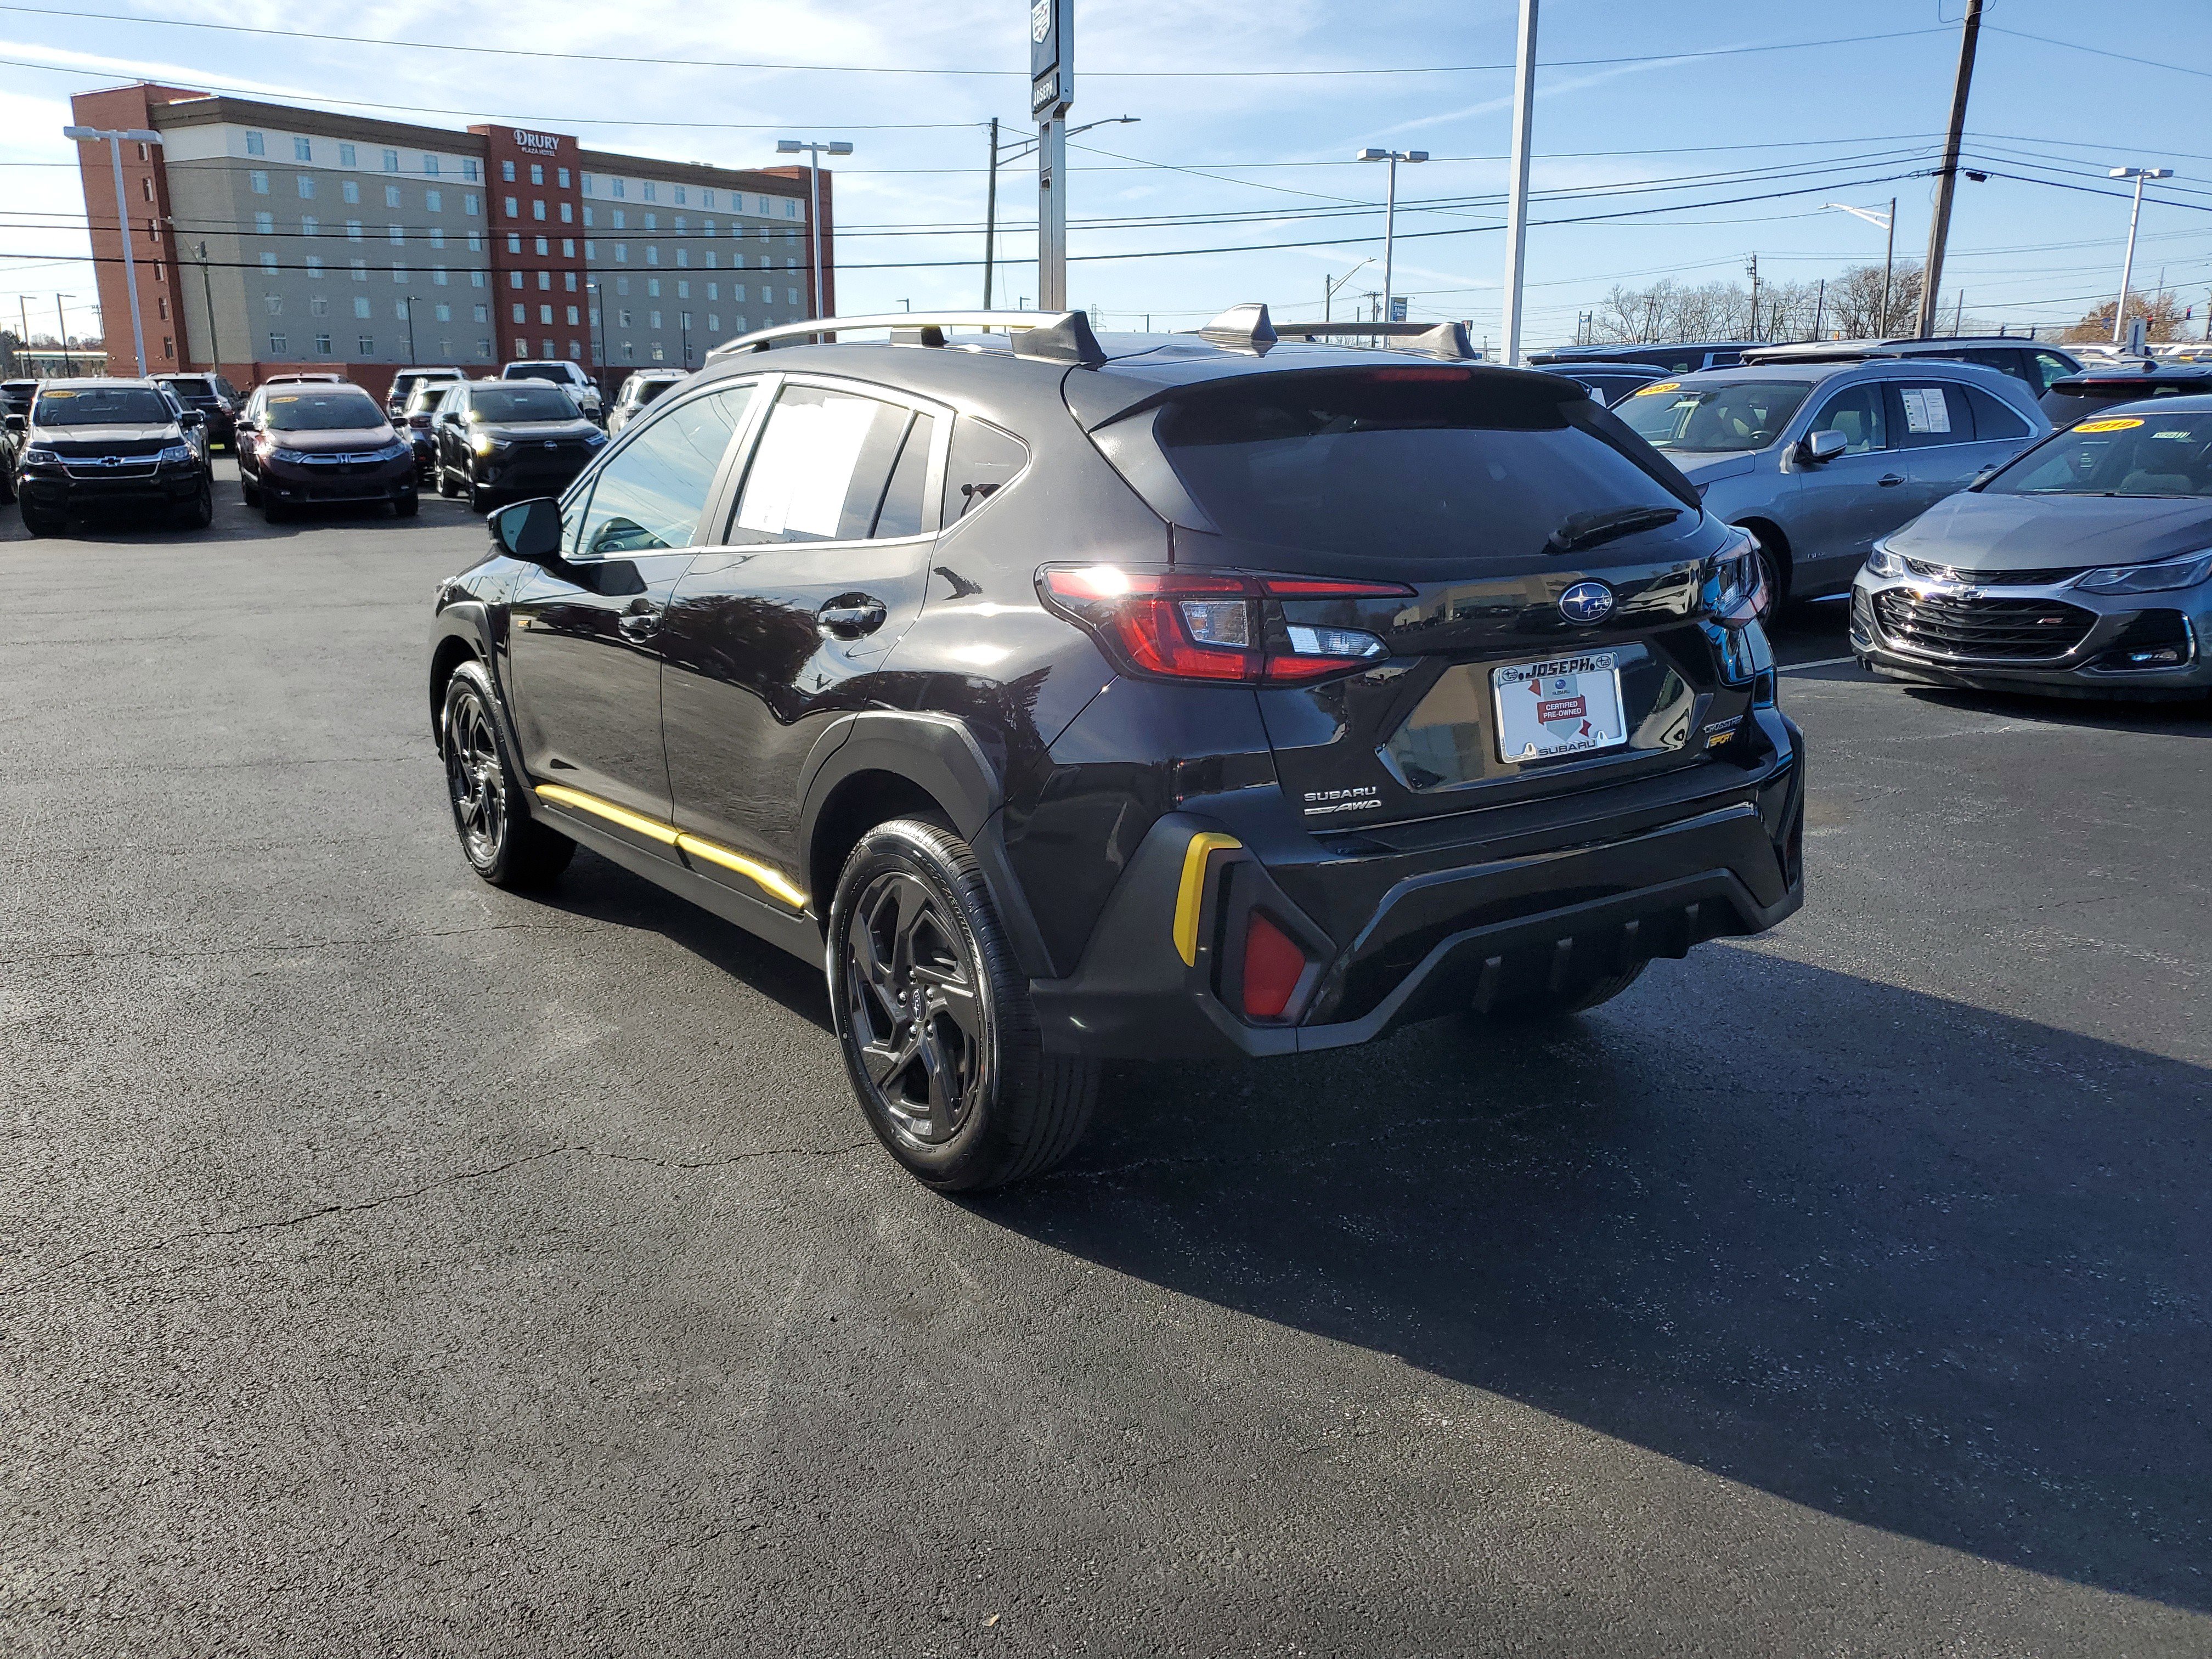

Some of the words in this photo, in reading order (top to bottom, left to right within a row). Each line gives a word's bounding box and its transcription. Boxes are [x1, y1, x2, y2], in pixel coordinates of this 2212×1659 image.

[1034, 81, 1053, 106] JOSEPH
[514, 129, 560, 150] DRURY
[2079, 421, 2136, 431] 2019
[1526, 658, 1590, 679] JOSEPH
[1543, 707, 1582, 719] PRE-OWNED
[1545, 701, 1578, 711] CERTIFIED
[1539, 740, 1596, 755] SUBARU
[1304, 786, 1376, 802] SUBARU
[1334, 799, 1383, 812] AWD
